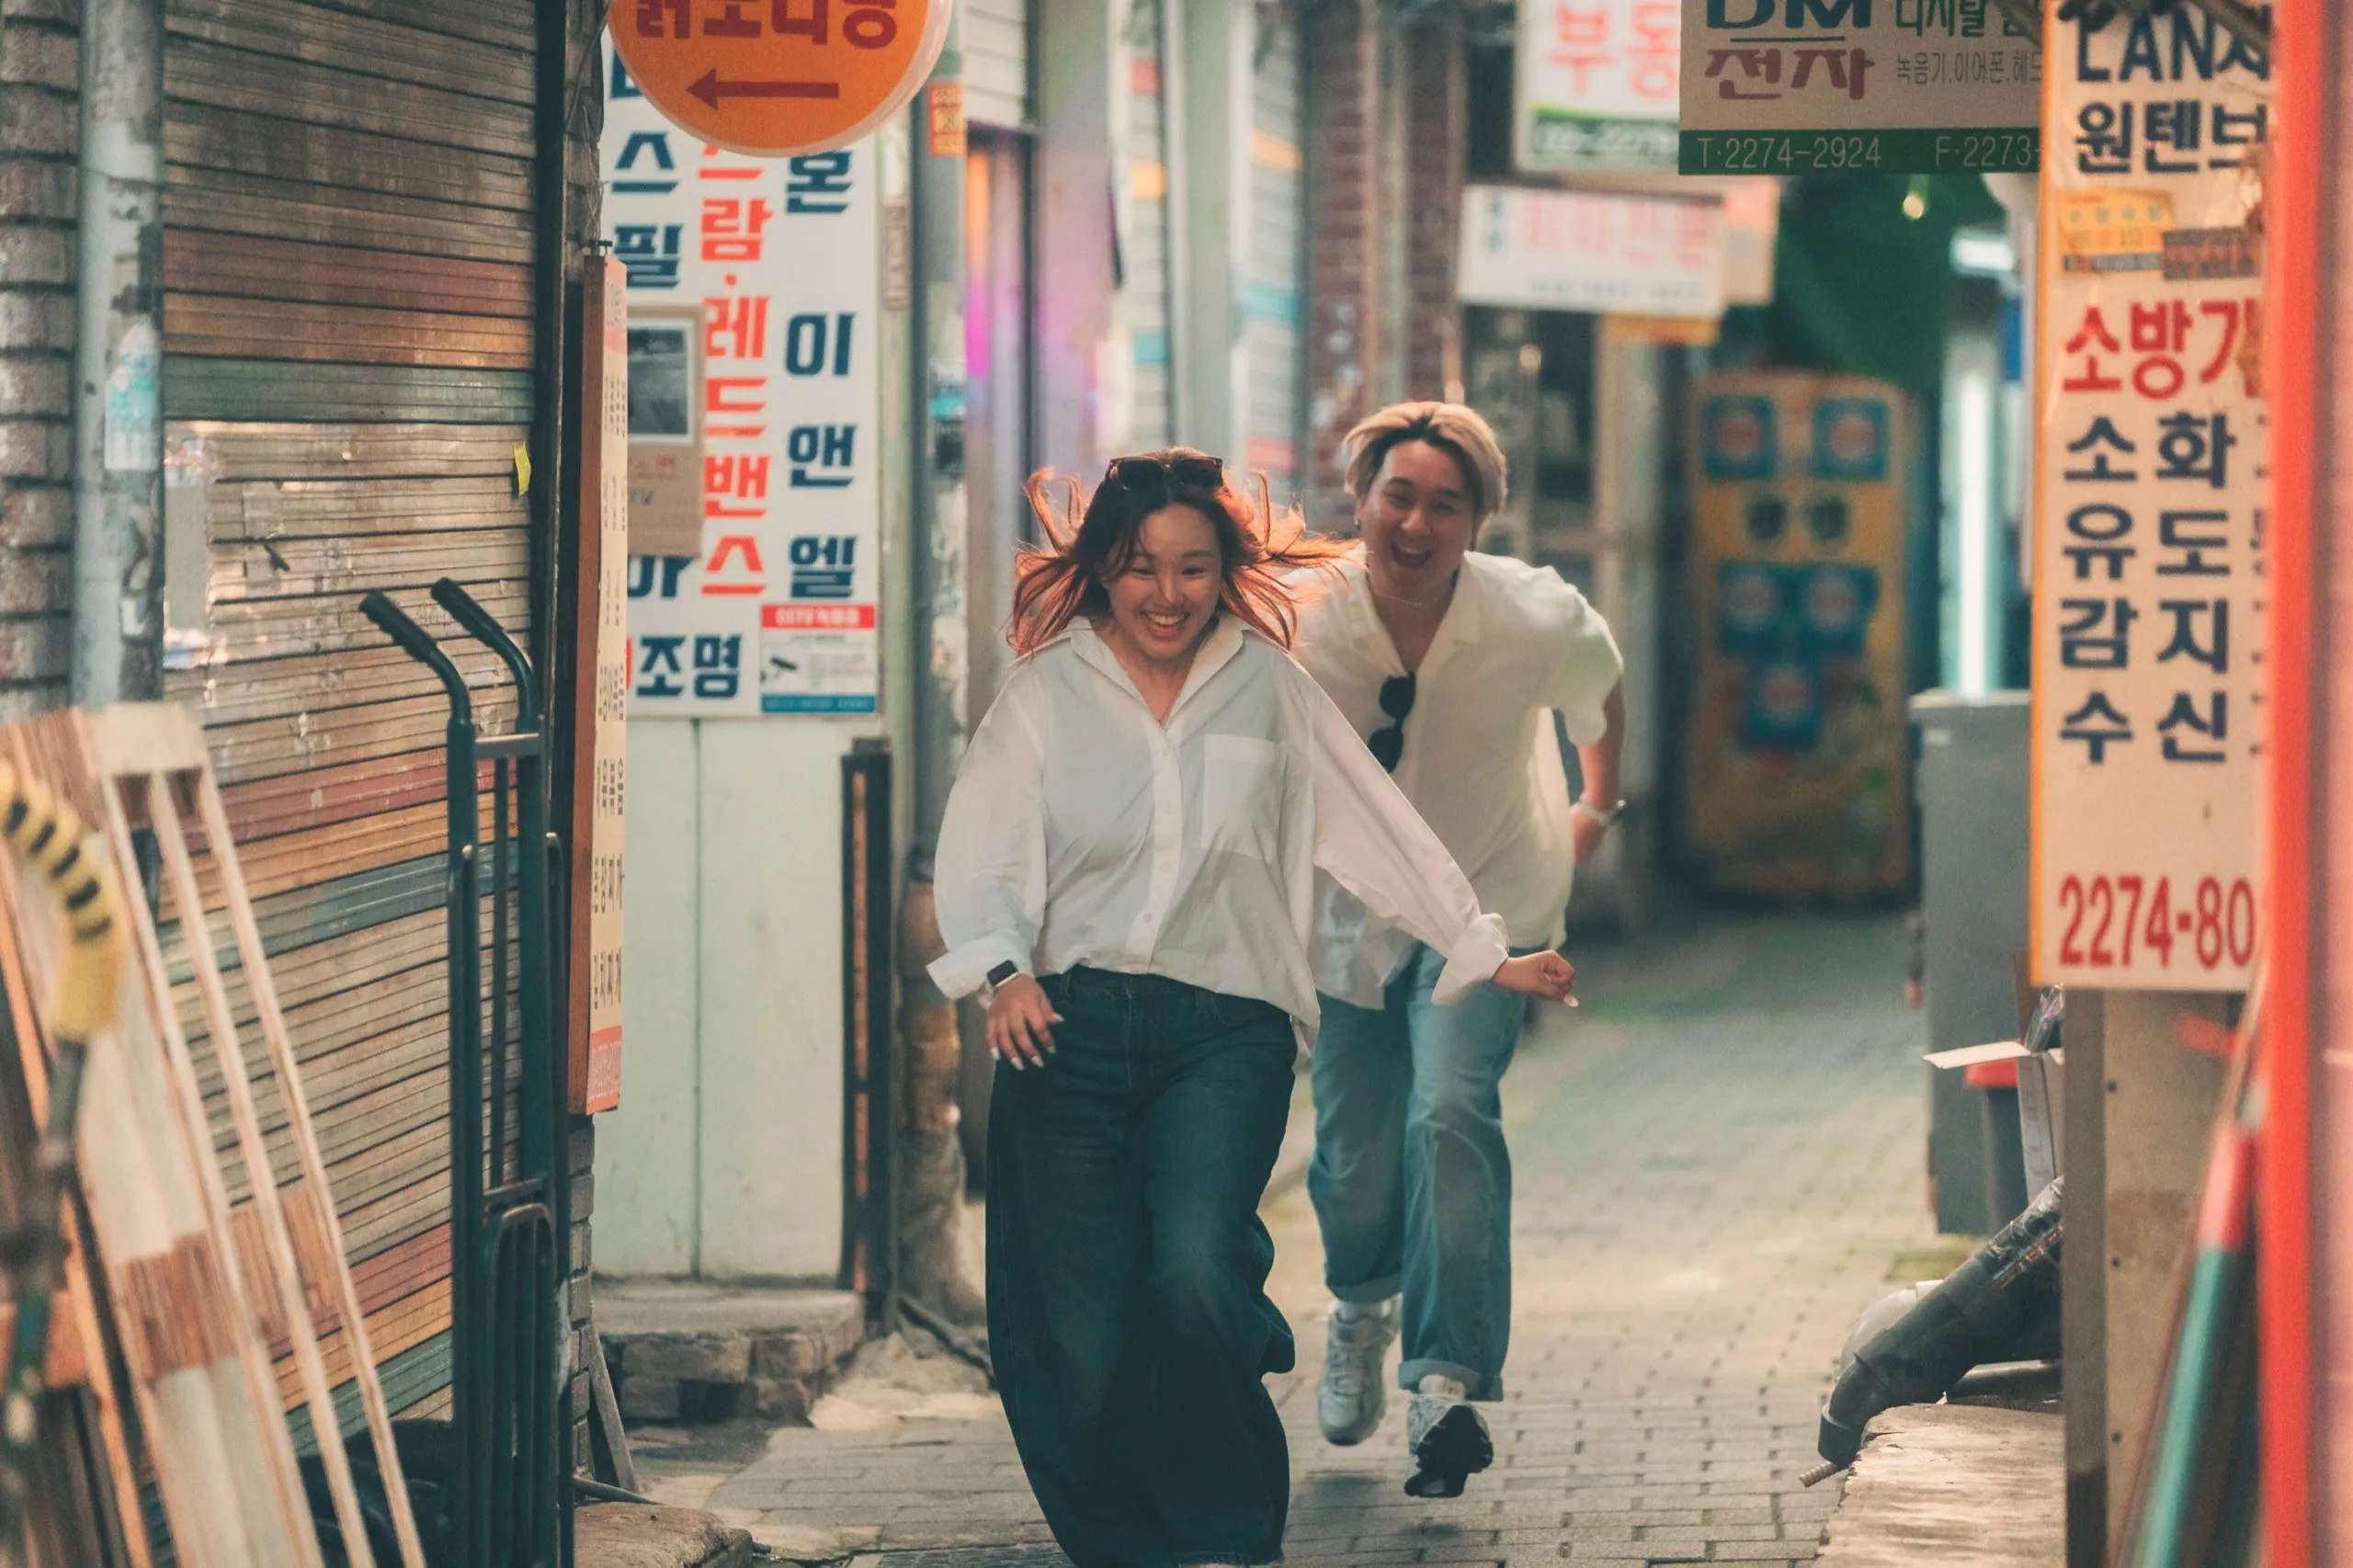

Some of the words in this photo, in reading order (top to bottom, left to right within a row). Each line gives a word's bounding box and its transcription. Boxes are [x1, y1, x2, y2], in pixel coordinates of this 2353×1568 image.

[1705, 48, 1875, 100] 전자
[2063, 411, 2267, 490] 소화
[2063, 504, 2267, 581] 유도
[627, 634, 742, 699] 조명
[2060, 597, 2265, 675] 감지
[2059, 691, 2263, 765] 수신
[593, 948, 622, 1009] 김치찌개
